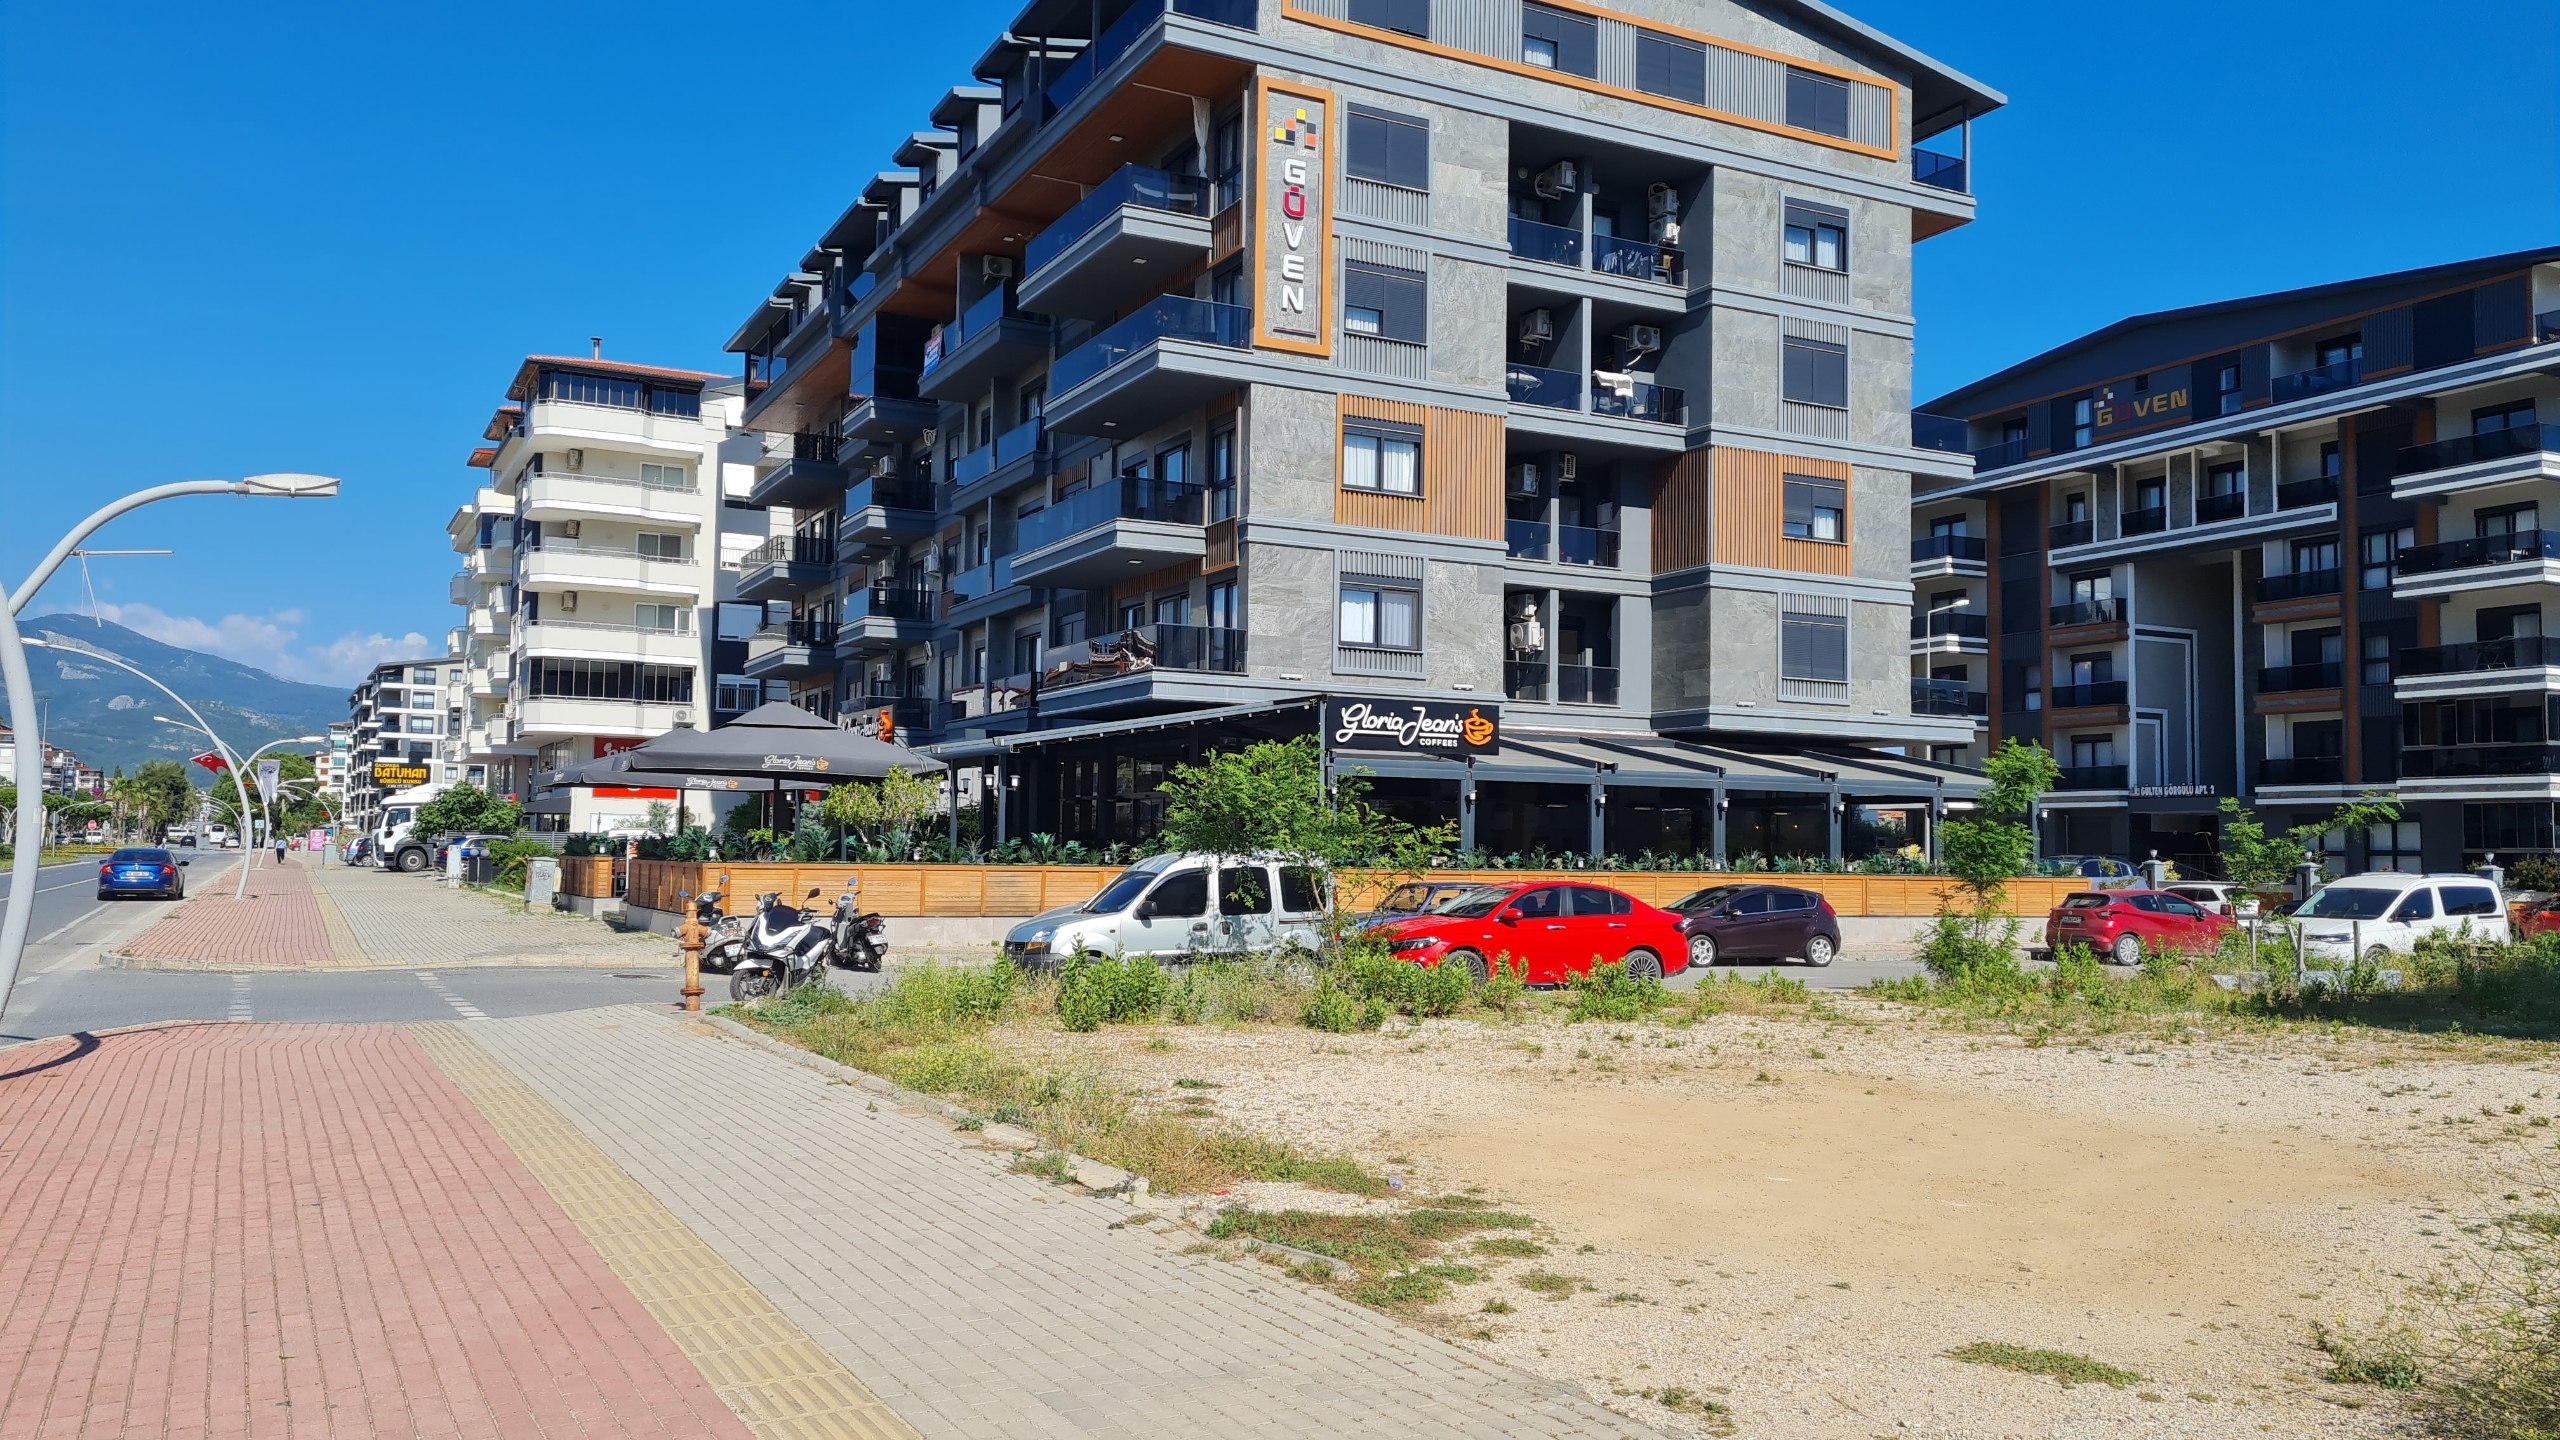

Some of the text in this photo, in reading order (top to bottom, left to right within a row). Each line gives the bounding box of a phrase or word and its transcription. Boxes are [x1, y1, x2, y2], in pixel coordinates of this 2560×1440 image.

[1282, 158, 1307, 312] GÜVEN
[1336, 703, 1464, 746] Gloria Jean's
[1419, 738, 1458, 748] COFFEES
[374, 767, 427, 779] BATUHAN
[2210, 785, 2215, 795] 2
